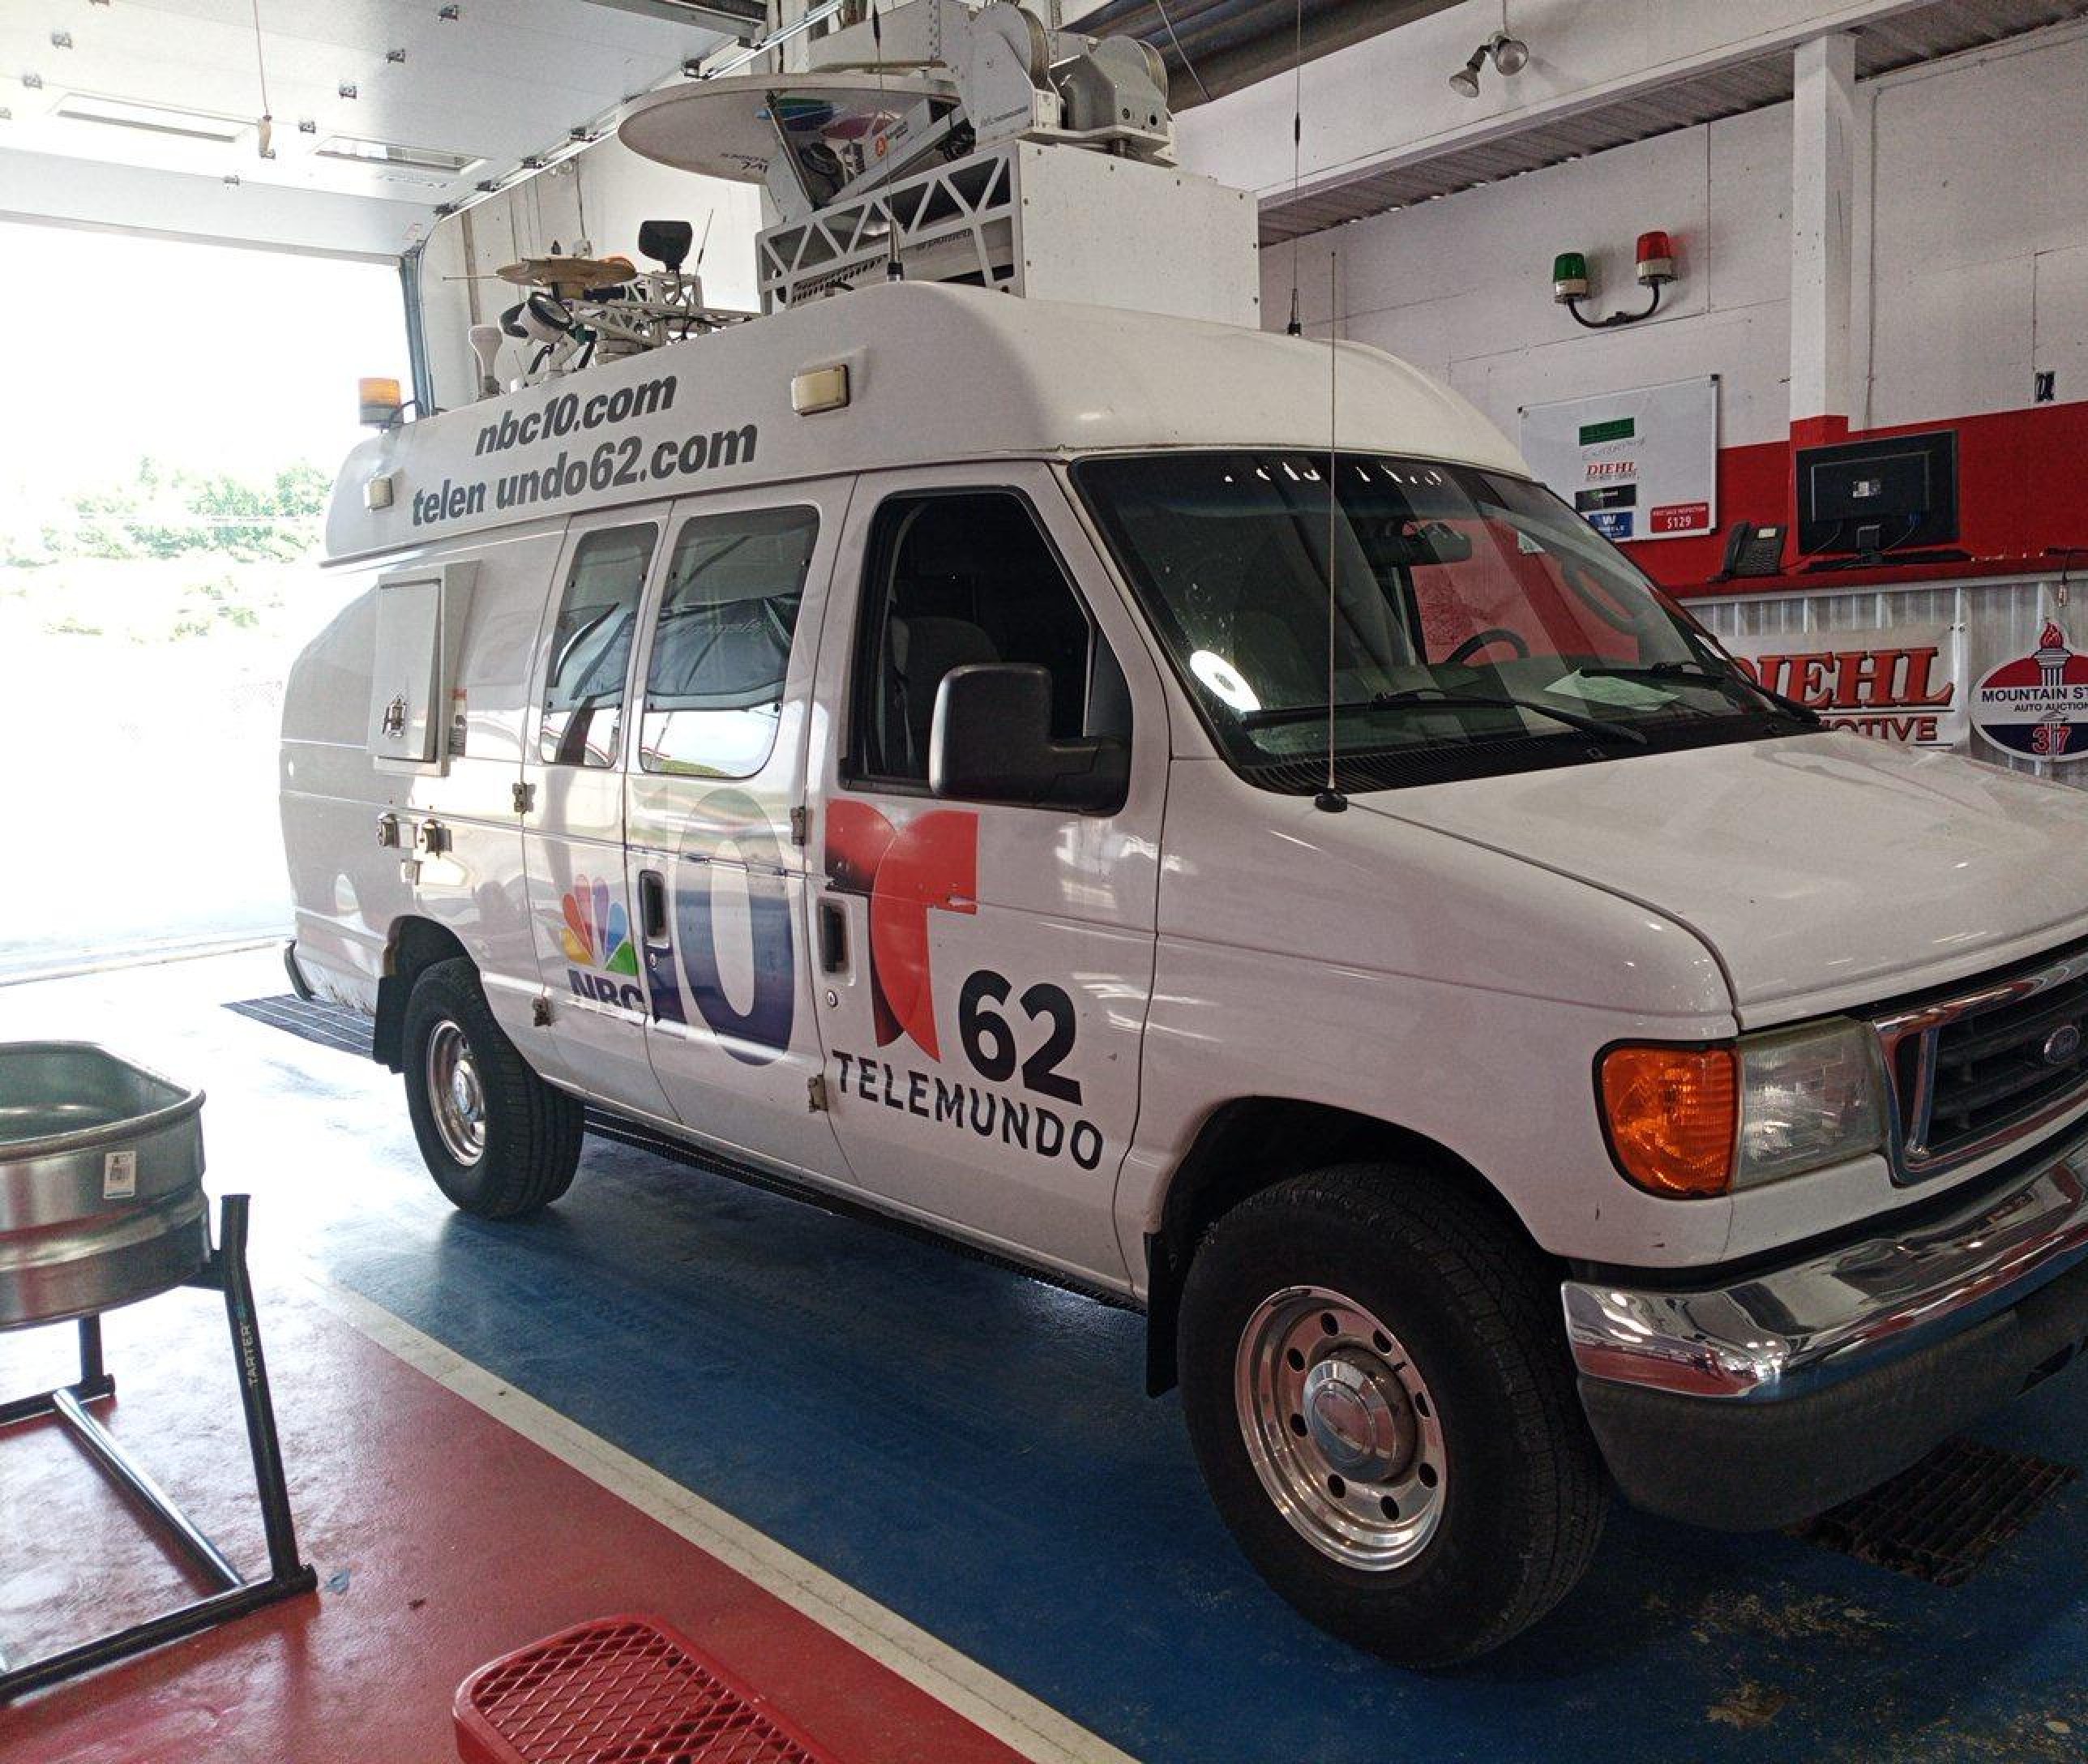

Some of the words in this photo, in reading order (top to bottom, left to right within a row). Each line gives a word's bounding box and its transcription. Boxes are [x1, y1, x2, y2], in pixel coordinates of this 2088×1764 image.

[475, 375, 678, 456] nbc10.com
[1736, 646, 1954, 709] IEHL
[1983, 687, 2067, 702] MOUNTAIN
[2013, 703, 2043, 712] AUTO
[1821, 717, 1937, 741] OTIVE
[959, 970, 1083, 1106] 62
[832, 1050, 1103, 1171] TELEMUNDO
